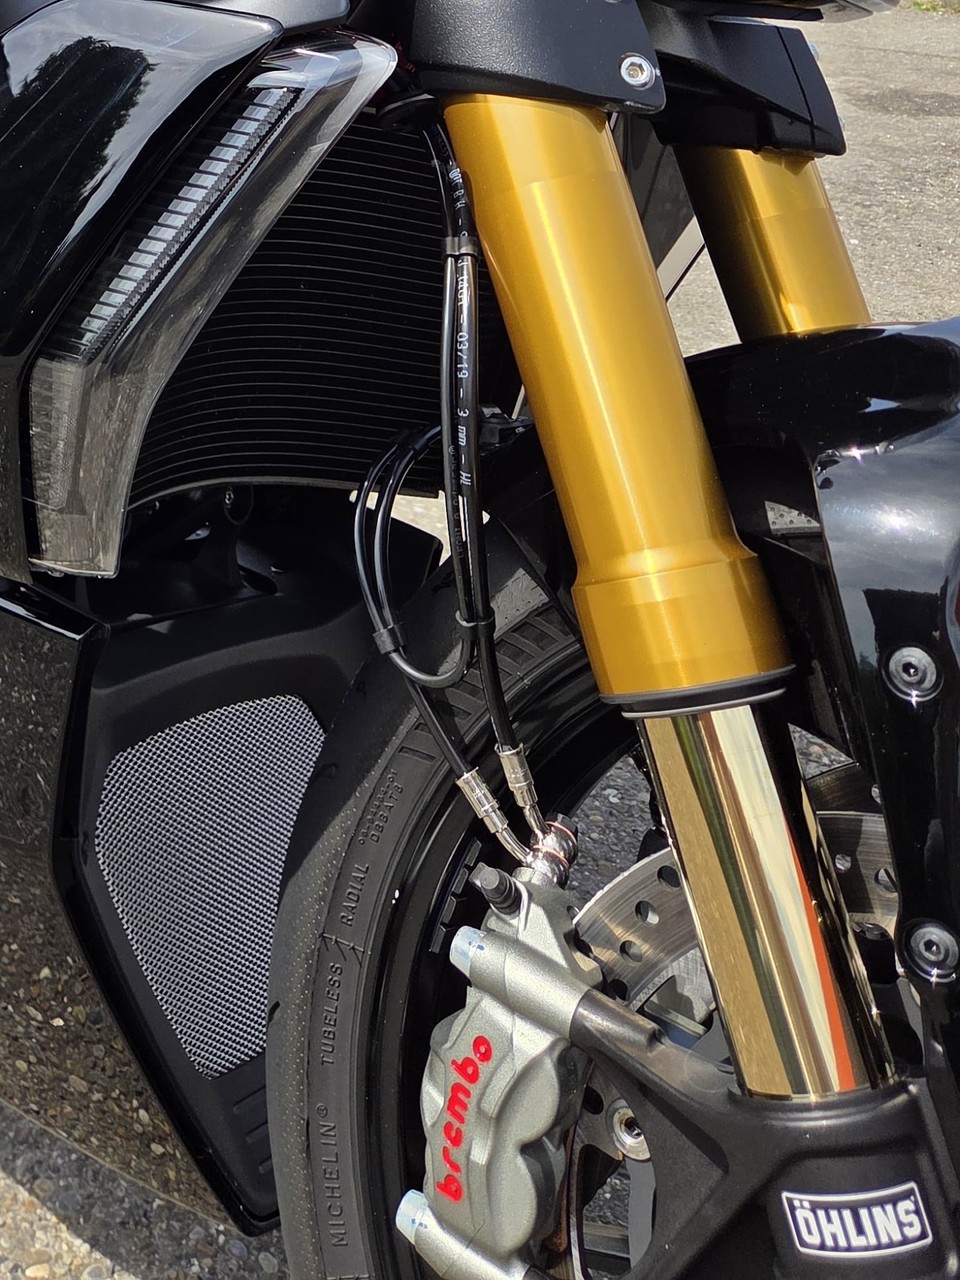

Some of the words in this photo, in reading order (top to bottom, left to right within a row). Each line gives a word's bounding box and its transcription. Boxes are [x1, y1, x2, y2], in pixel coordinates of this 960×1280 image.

[457, 332, 469, 379] 03/19
[340, 863, 370, 926] RADIAL
[321, 963, 343, 1066] TUBELESS
[436, 1035, 493, 1202] brembo
[793, 1197, 922, 1247] ÖHLINS
